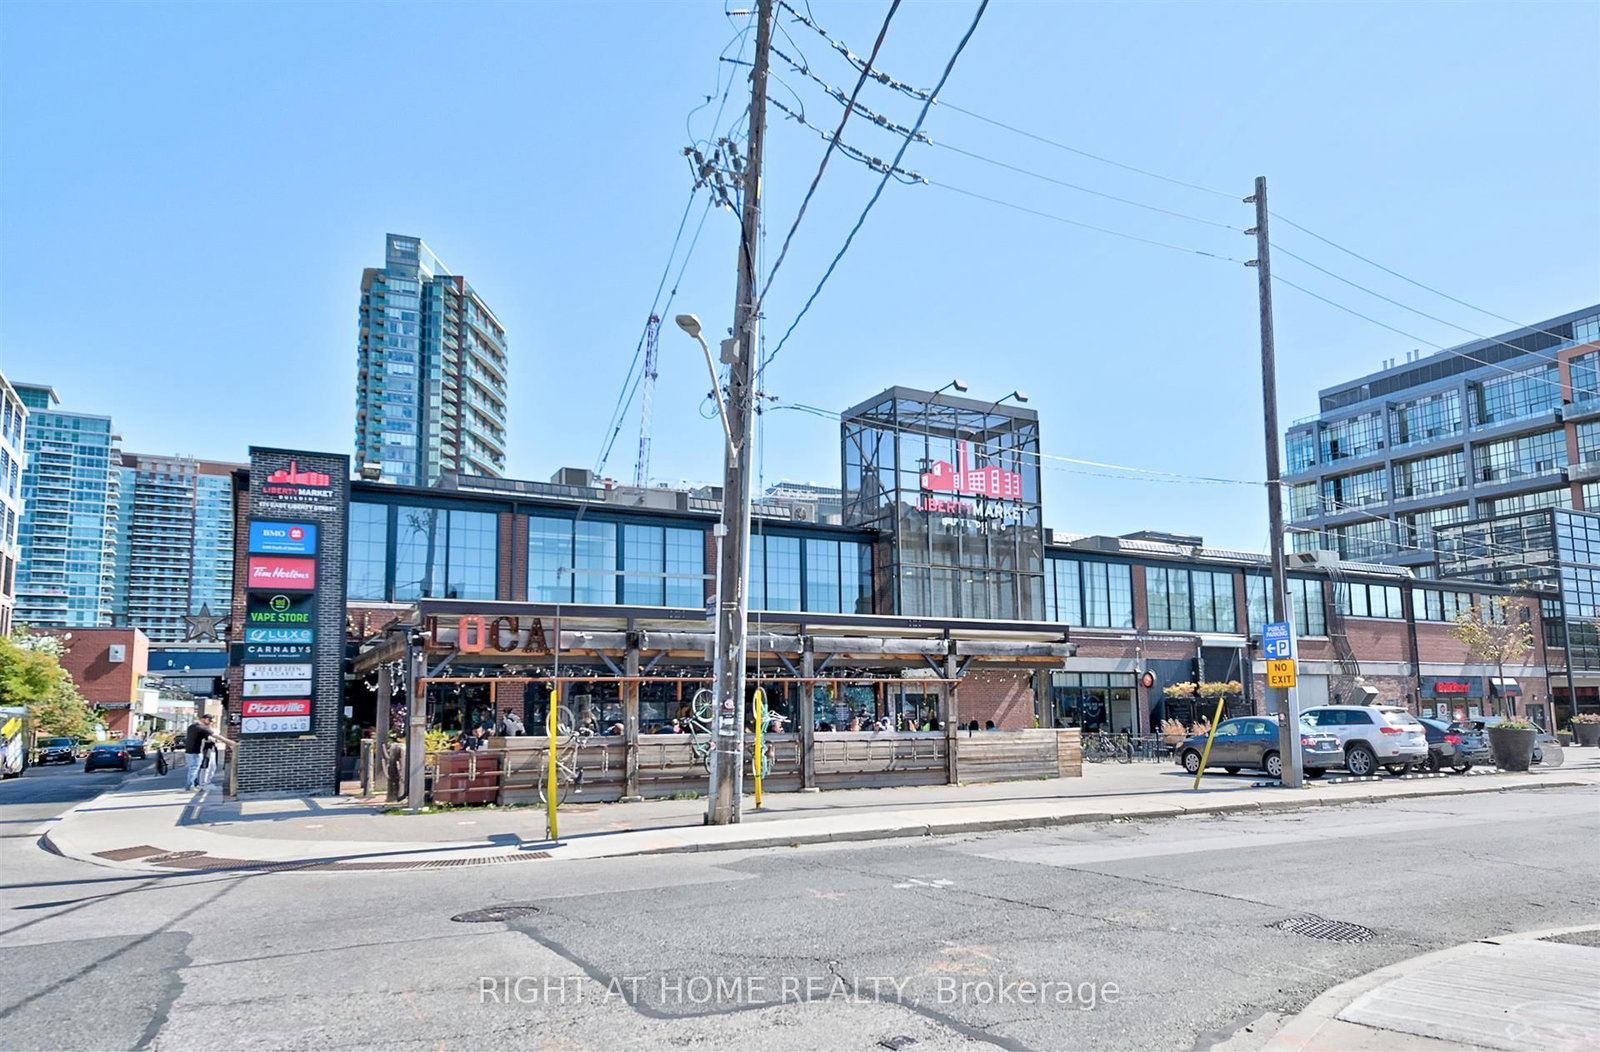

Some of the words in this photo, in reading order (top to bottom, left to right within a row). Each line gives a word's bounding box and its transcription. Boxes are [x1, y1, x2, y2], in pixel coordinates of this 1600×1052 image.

[263, 529, 286, 537] BMO
[253, 566, 272, 578] Tim
[272, 568, 309, 579] Hortons
[251, 612, 276, 622] VAPE
[278, 613, 309, 622] STORE
[1279, 642, 1287, 654] P
[1274, 663, 1287, 671] NO
[1272, 675, 1292, 684] EXIT
[247, 702, 305, 714] Pizzaville
